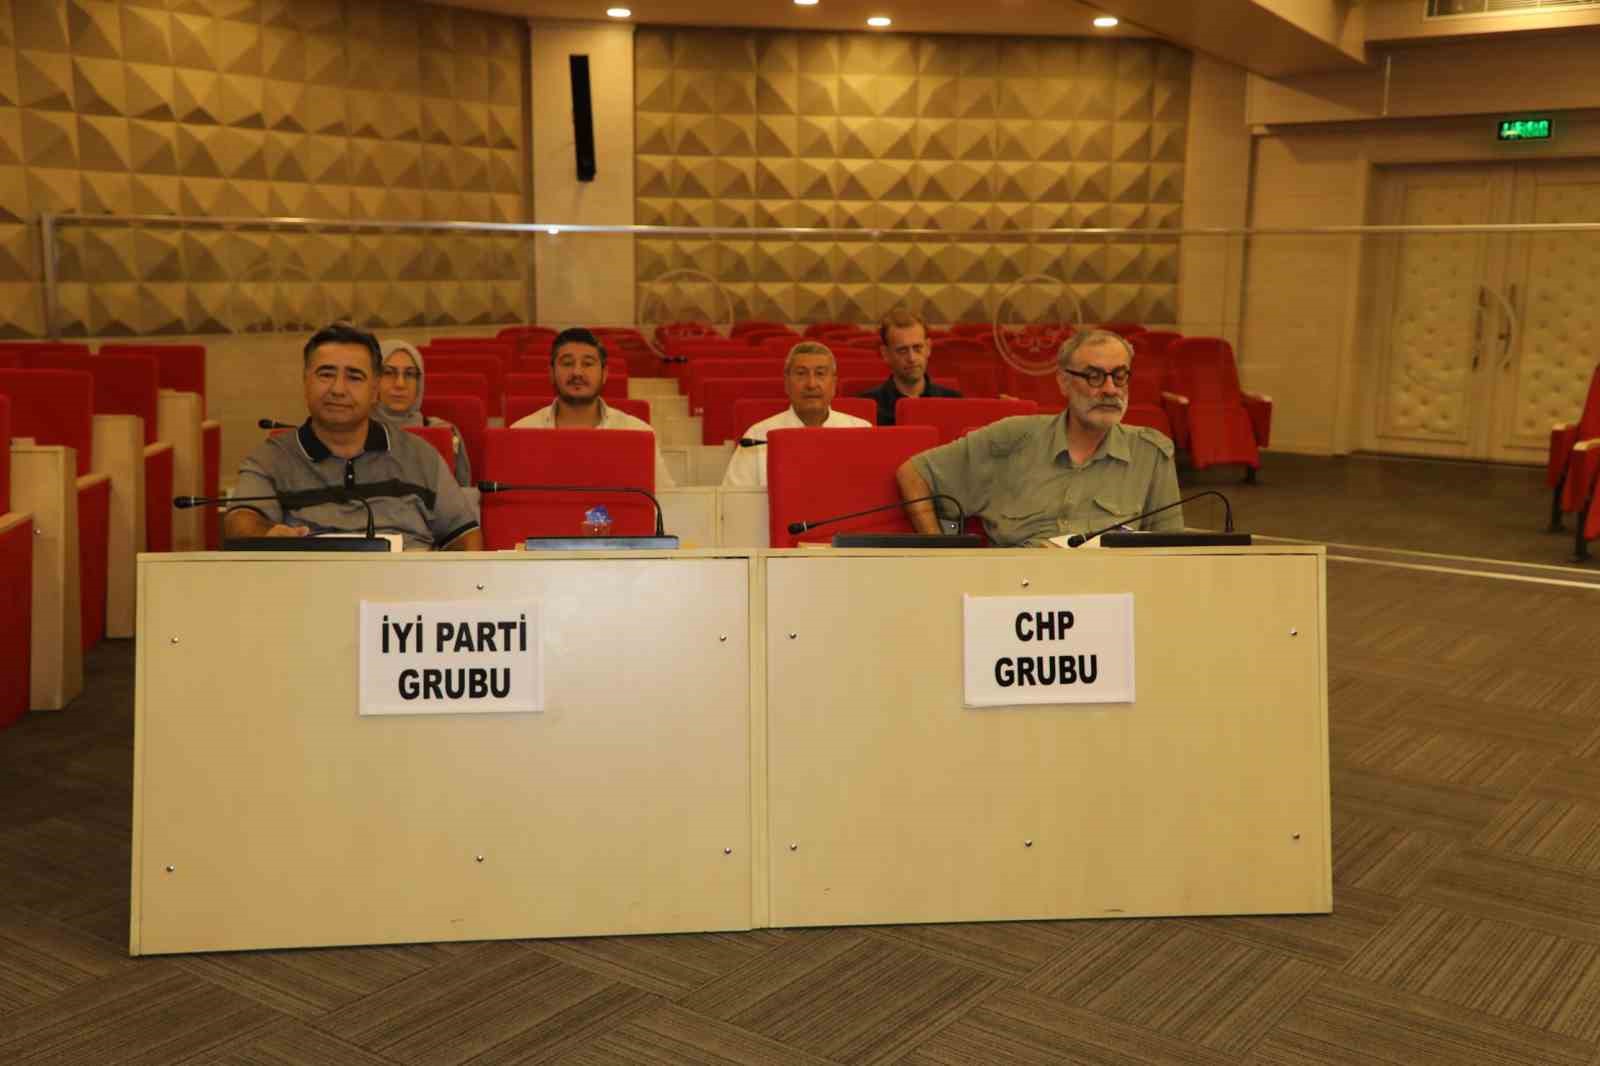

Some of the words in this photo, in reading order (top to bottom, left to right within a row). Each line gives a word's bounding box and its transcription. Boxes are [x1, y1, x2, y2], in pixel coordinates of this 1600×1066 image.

[381, 614, 424, 654] İYİ
[436, 613, 527, 653] PARTİ
[1015, 610, 1075, 642] CHP
[398, 667, 511, 701] GRUBU
[994, 654, 1098, 688] GRUBU
